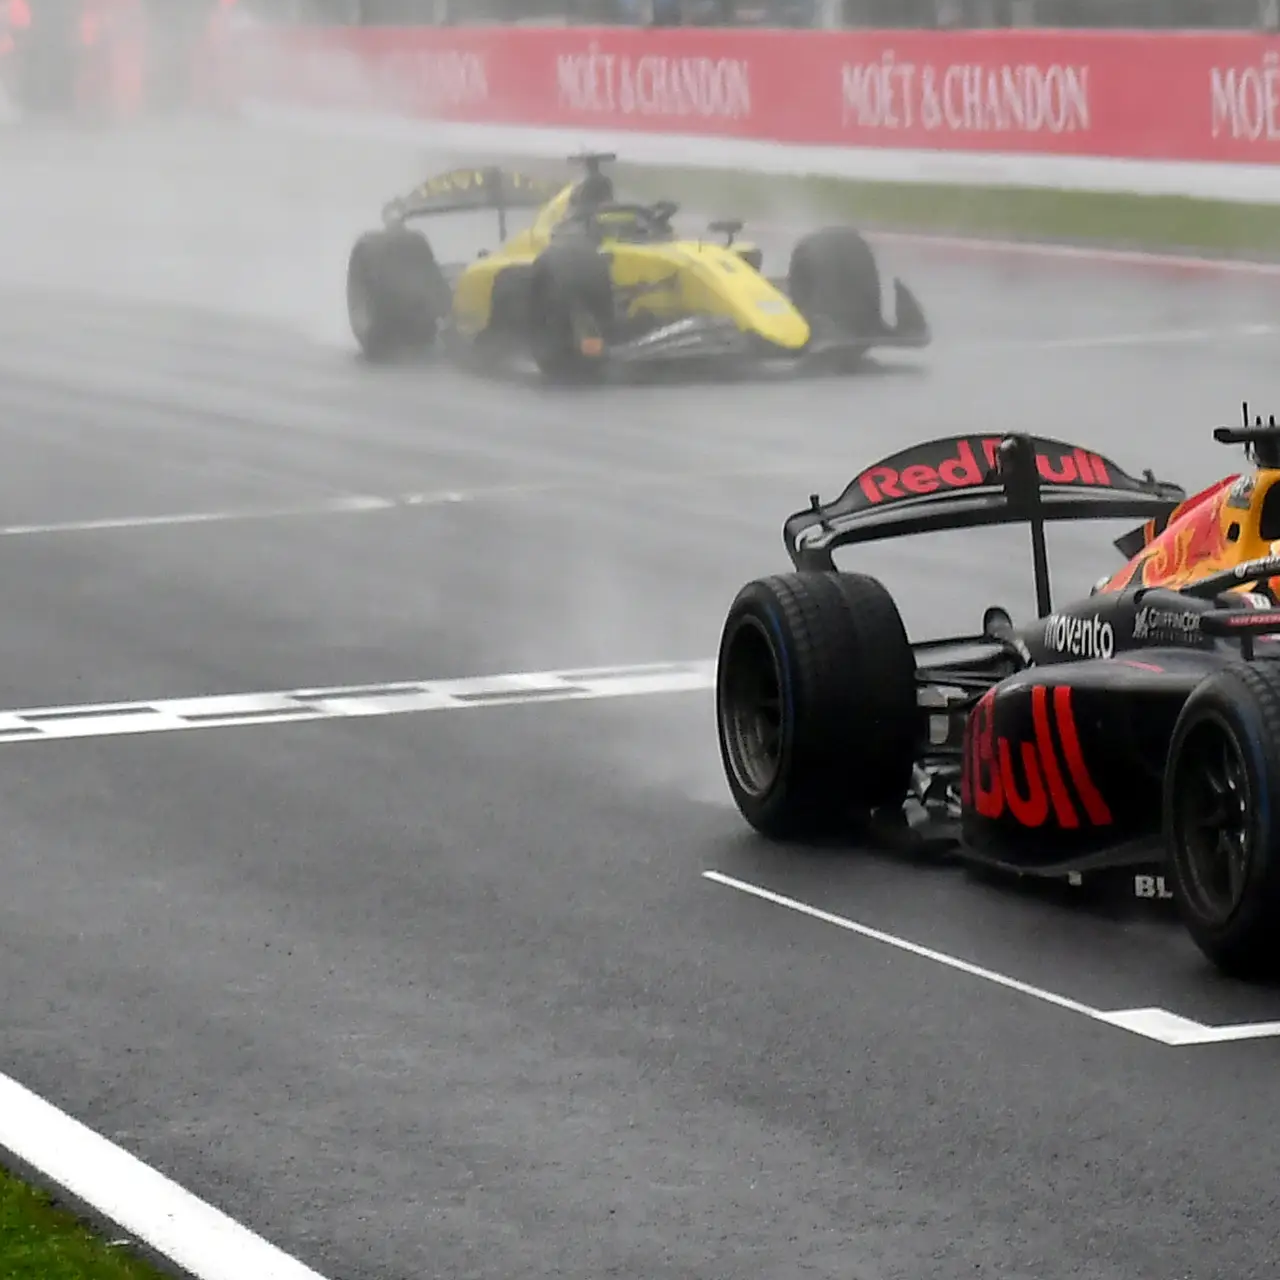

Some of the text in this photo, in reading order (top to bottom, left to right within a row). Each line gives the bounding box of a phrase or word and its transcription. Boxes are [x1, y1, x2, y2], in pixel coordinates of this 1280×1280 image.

[637, 55, 751, 118] CHANDON
[944, 64, 1090, 132] CHANDON
[857, 438, 1112, 504] Red ull
[1044, 612, 1115, 660] movento
